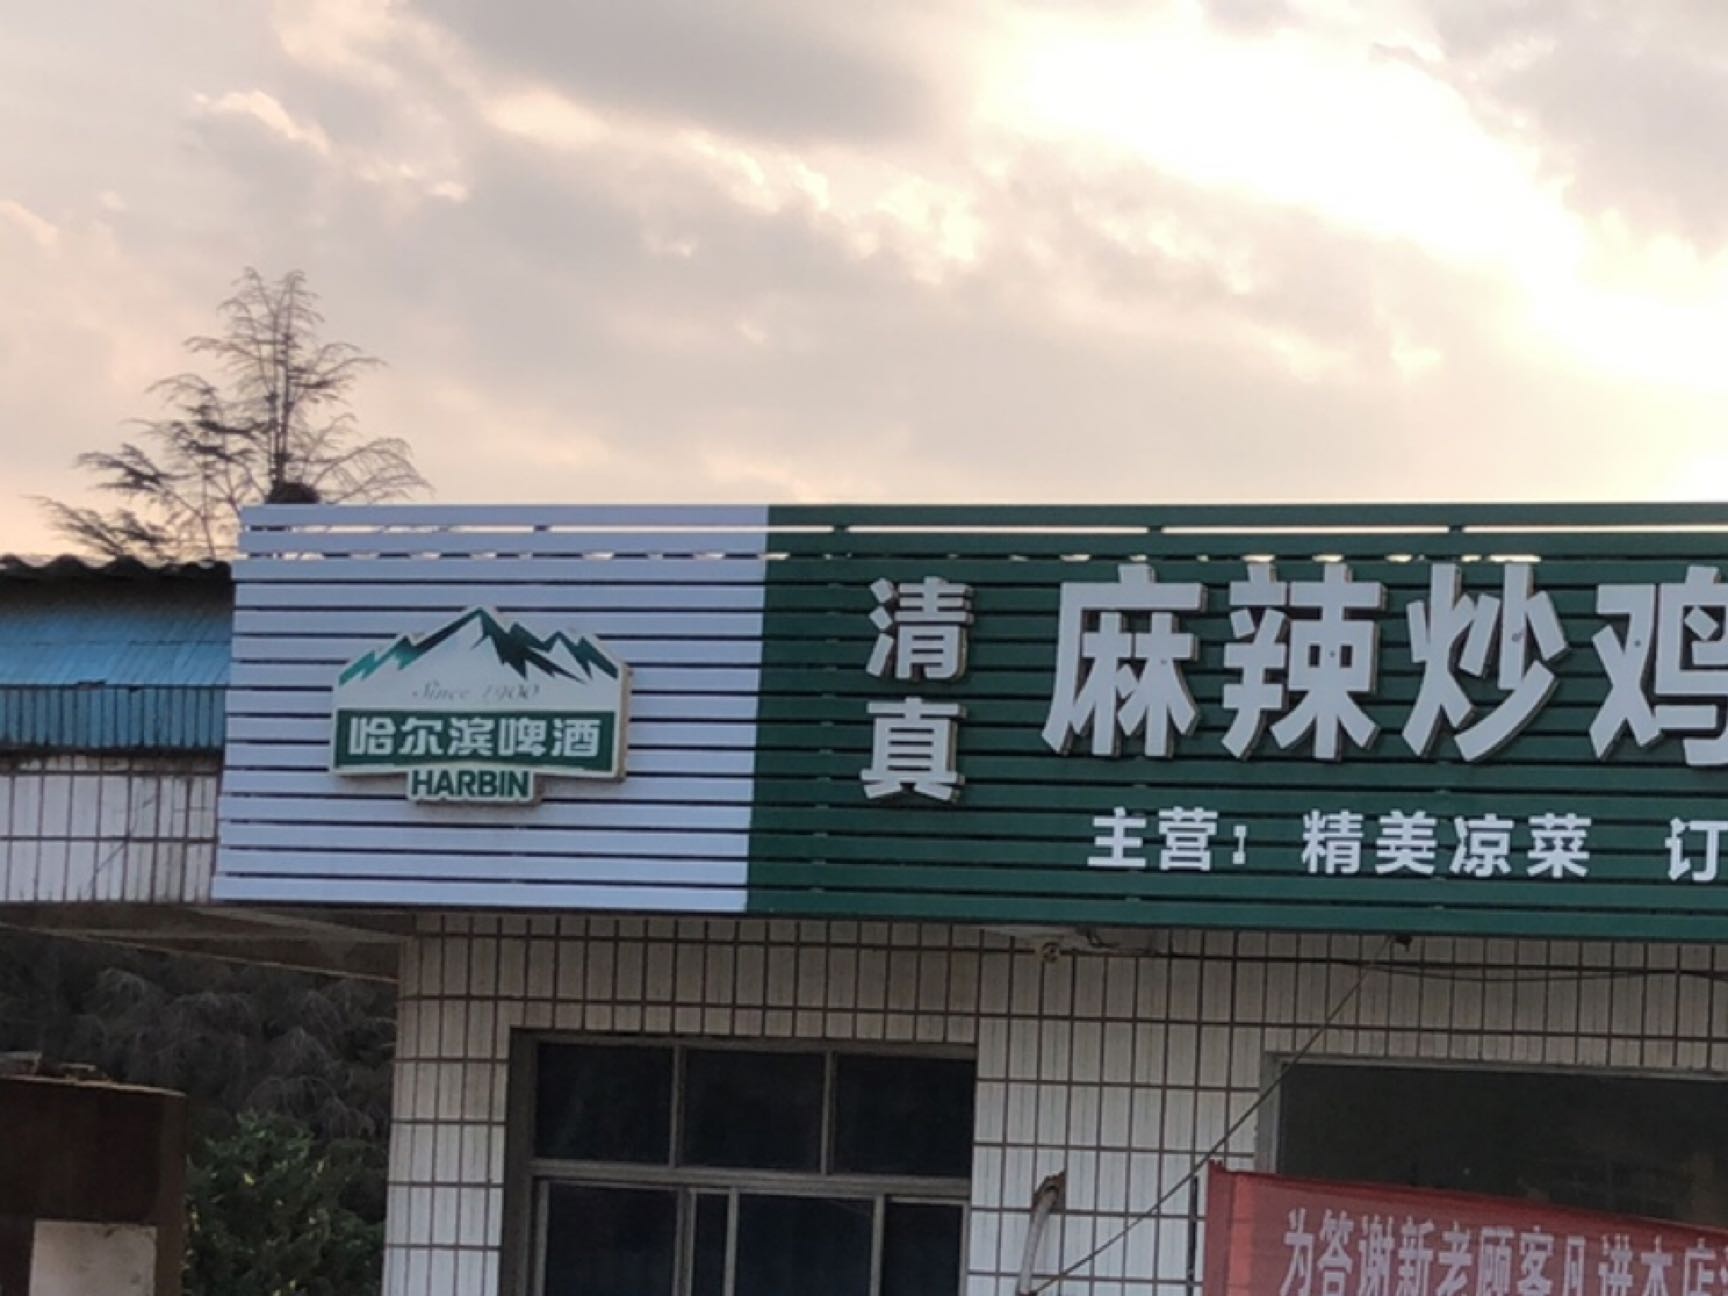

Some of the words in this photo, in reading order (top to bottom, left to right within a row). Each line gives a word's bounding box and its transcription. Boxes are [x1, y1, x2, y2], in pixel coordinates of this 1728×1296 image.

[862, 576, 976, 803] 清真
[349, 717, 601, 757] 哈尔滨啤酒
[411, 769, 530, 798] HARBIN
[1302, 810, 1592, 878] 精美凉菜
